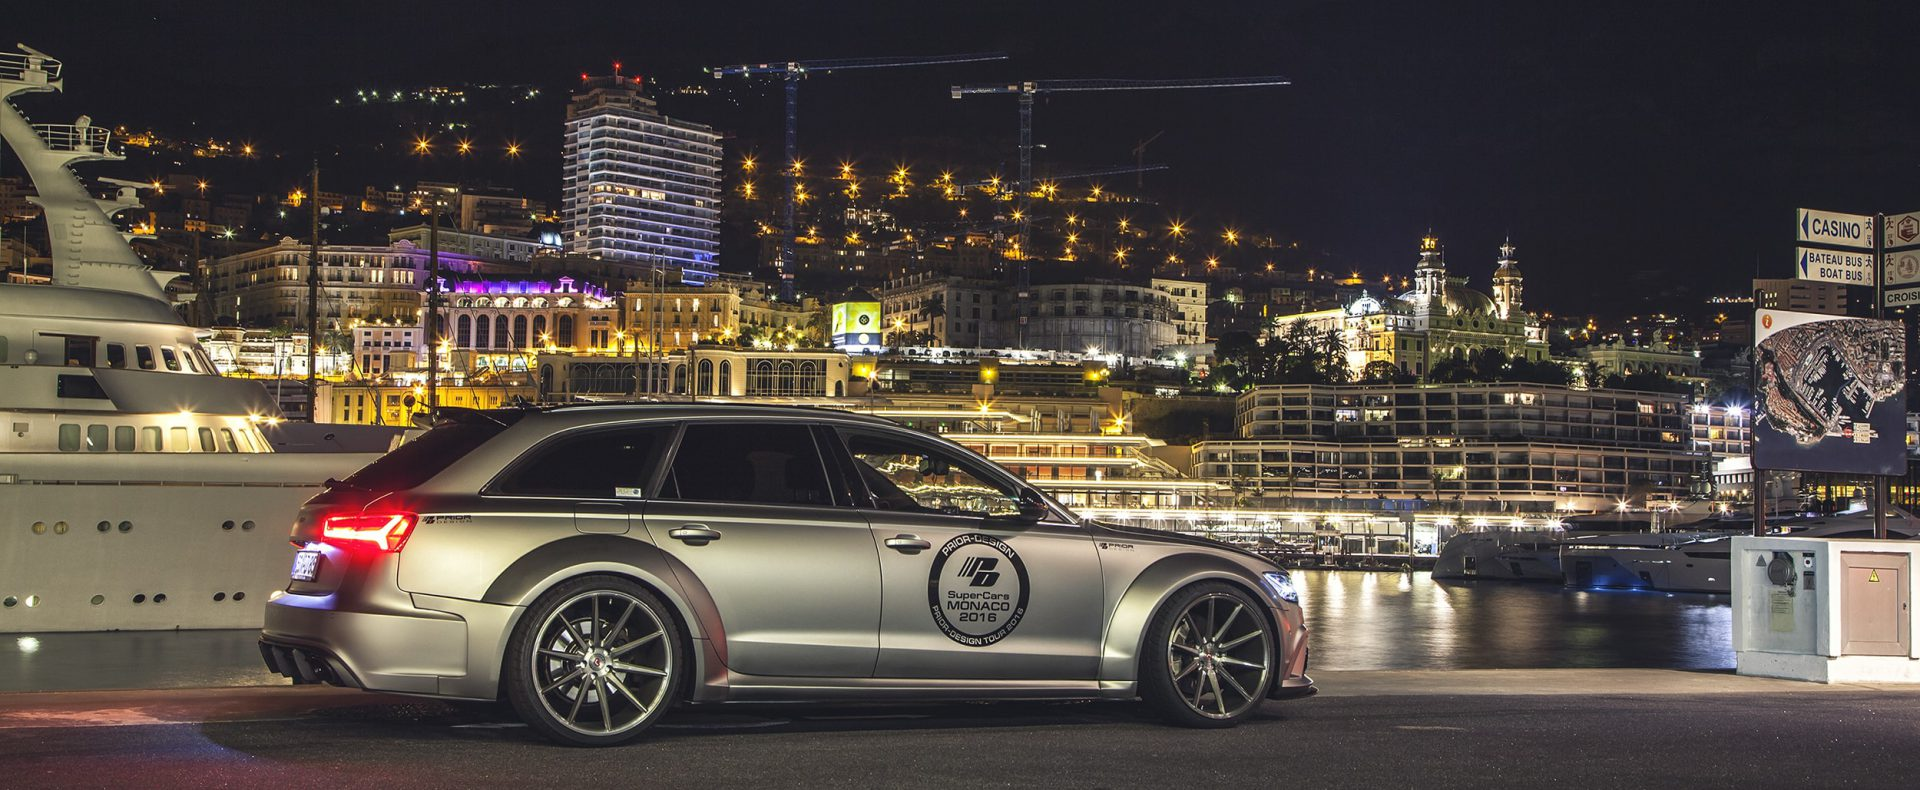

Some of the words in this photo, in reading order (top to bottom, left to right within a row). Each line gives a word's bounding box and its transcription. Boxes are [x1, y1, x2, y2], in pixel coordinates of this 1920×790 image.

[1812, 218, 1860, 239] CASINO
[1809, 252, 1843, 266] BATEAU
[1845, 256, 1863, 267] BUS
[1820, 267, 1843, 279] BOAT
[1845, 270, 1863, 281] BUS
[941, 535, 1015, 559] PRIOR-DESIGN
[947, 590, 1010, 600] SuperCars
[947, 601, 1010, 611] MONACO
[959, 612, 997, 622] 2016
[932, 605, 982, 645] PRIOR-DESIGN
[983, 629, 1007, 644] TOUR
[1006, 608, 1024, 631] 2016
